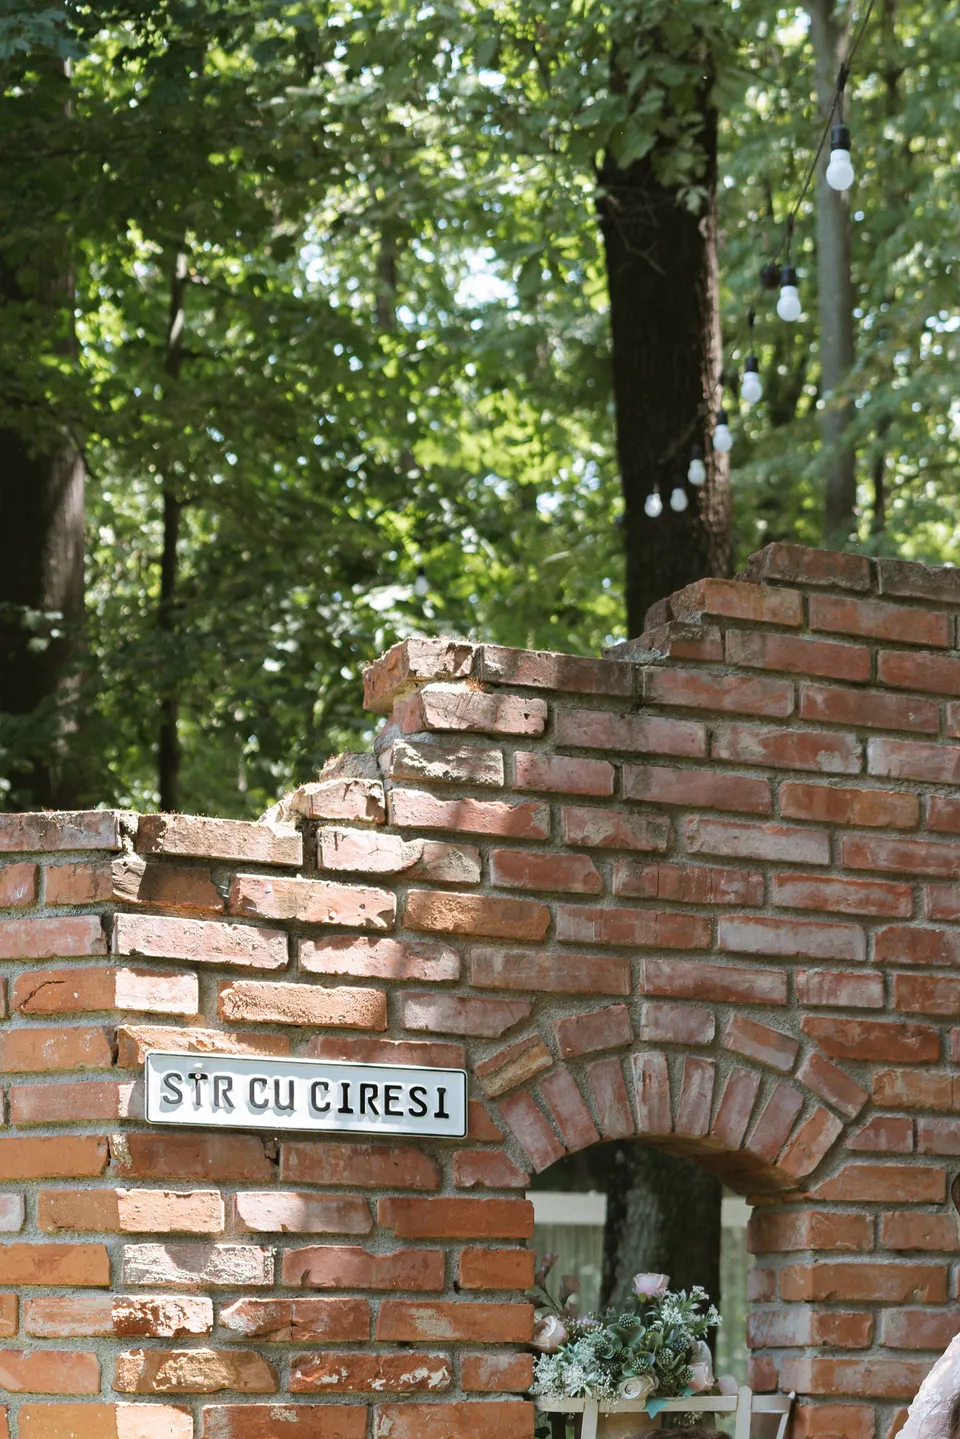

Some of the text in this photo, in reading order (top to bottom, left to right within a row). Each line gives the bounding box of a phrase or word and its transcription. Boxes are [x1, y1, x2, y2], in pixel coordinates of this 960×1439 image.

[162, 1072, 450, 1119] STR CU CIRESI
